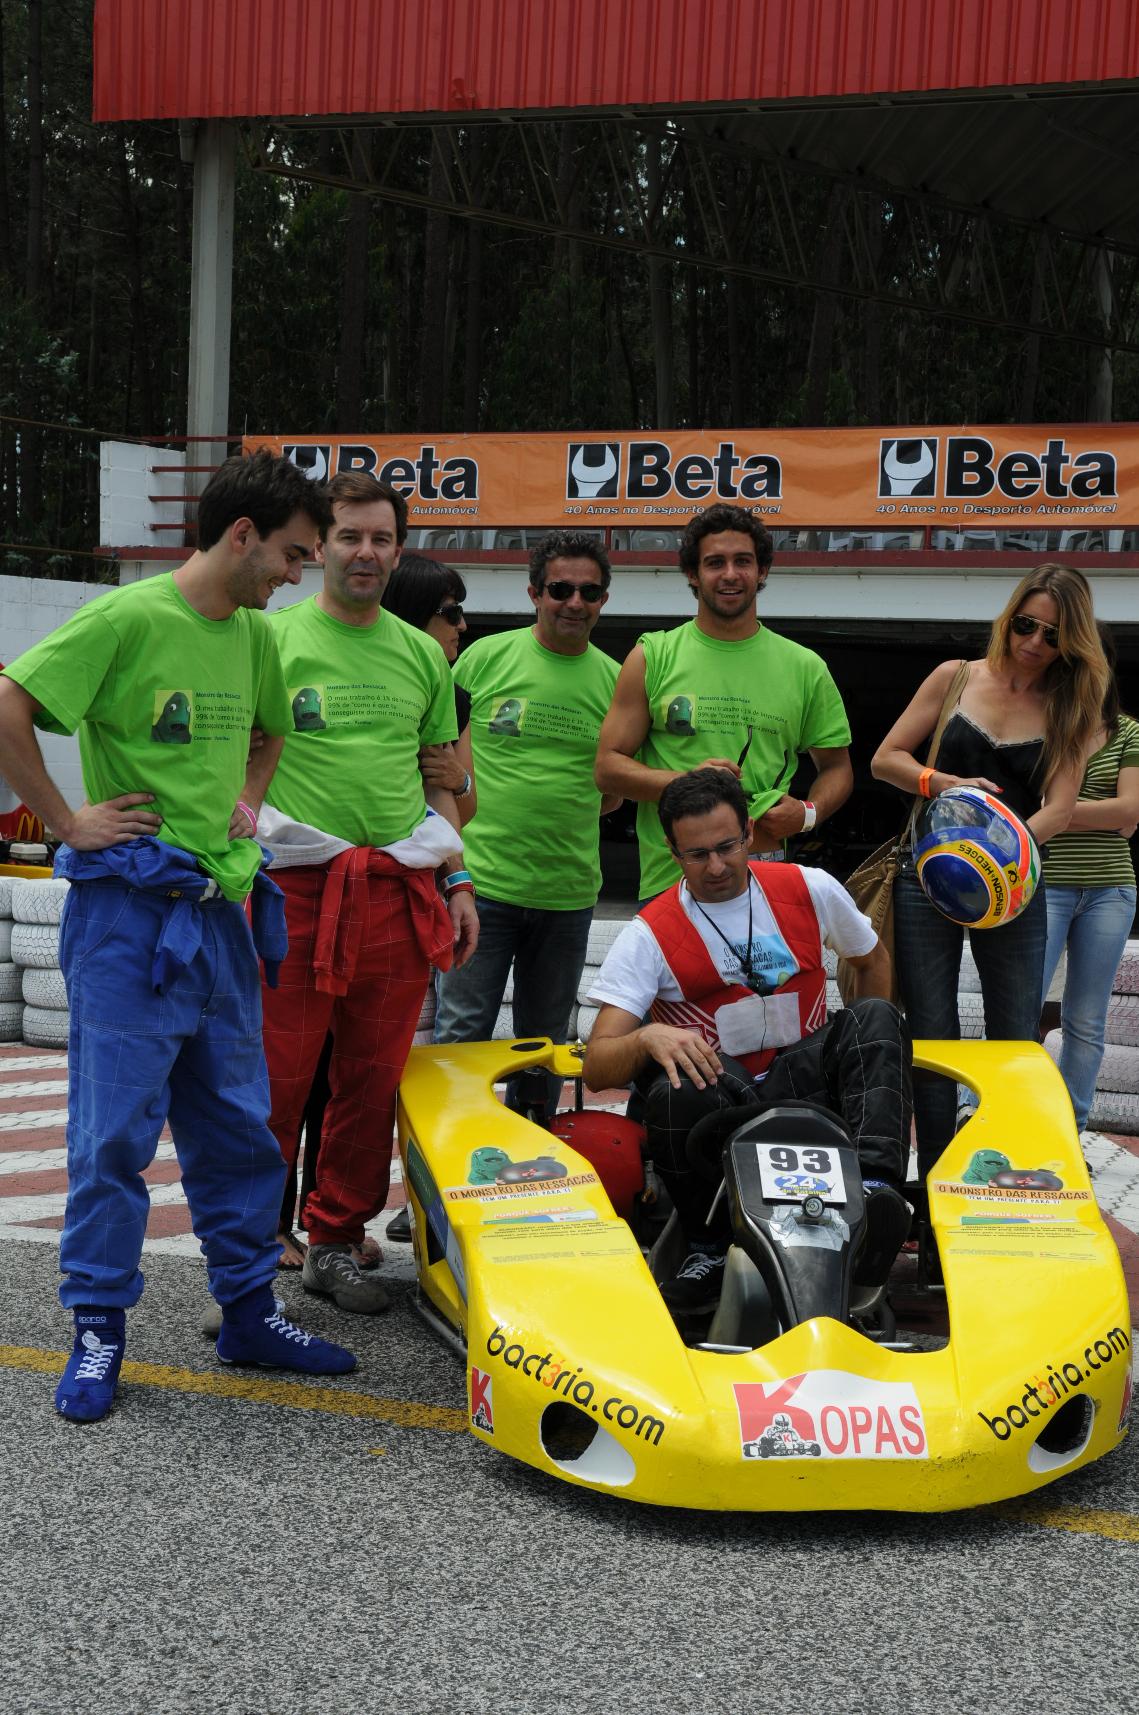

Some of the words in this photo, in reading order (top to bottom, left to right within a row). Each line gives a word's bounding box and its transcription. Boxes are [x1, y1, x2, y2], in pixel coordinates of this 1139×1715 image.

[337, 444, 479, 500] Beta
[626, 441, 783, 500] Beta
[944, 436, 1119, 500] Beta
[411, 505, 479, 515] Automóvel
[564, 505, 582, 514] 40
[585, 505, 619, 514] Anos
[622, 506, 639, 514] no
[642, 505, 705, 516] Desporto
[875, 504, 896, 514] 40
[899, 504, 936, 513] Anos
[940, 505, 958, 514] no
[963, 503, 1032, 515] Desporto
[1036, 503, 1117, 515] Automóvel
[958, 844, 993, 875] HEDGES
[724, 958, 738, 970] DAS
[769, 1147, 832, 1174] 93
[450, 1192, 458, 1200] O
[461, 1186, 514, 1200] MONSTRO
[516, 1183, 538, 1193] DAS
[540, 1174, 596, 1190] RESSACAS
[783, 1175, 816, 1188] 24
[950, 1186, 1002, 1197] MONSTRO
[1006, 1190, 1028, 1198] DAS
[1031, 1191, 1088, 1200] RESSACAS
